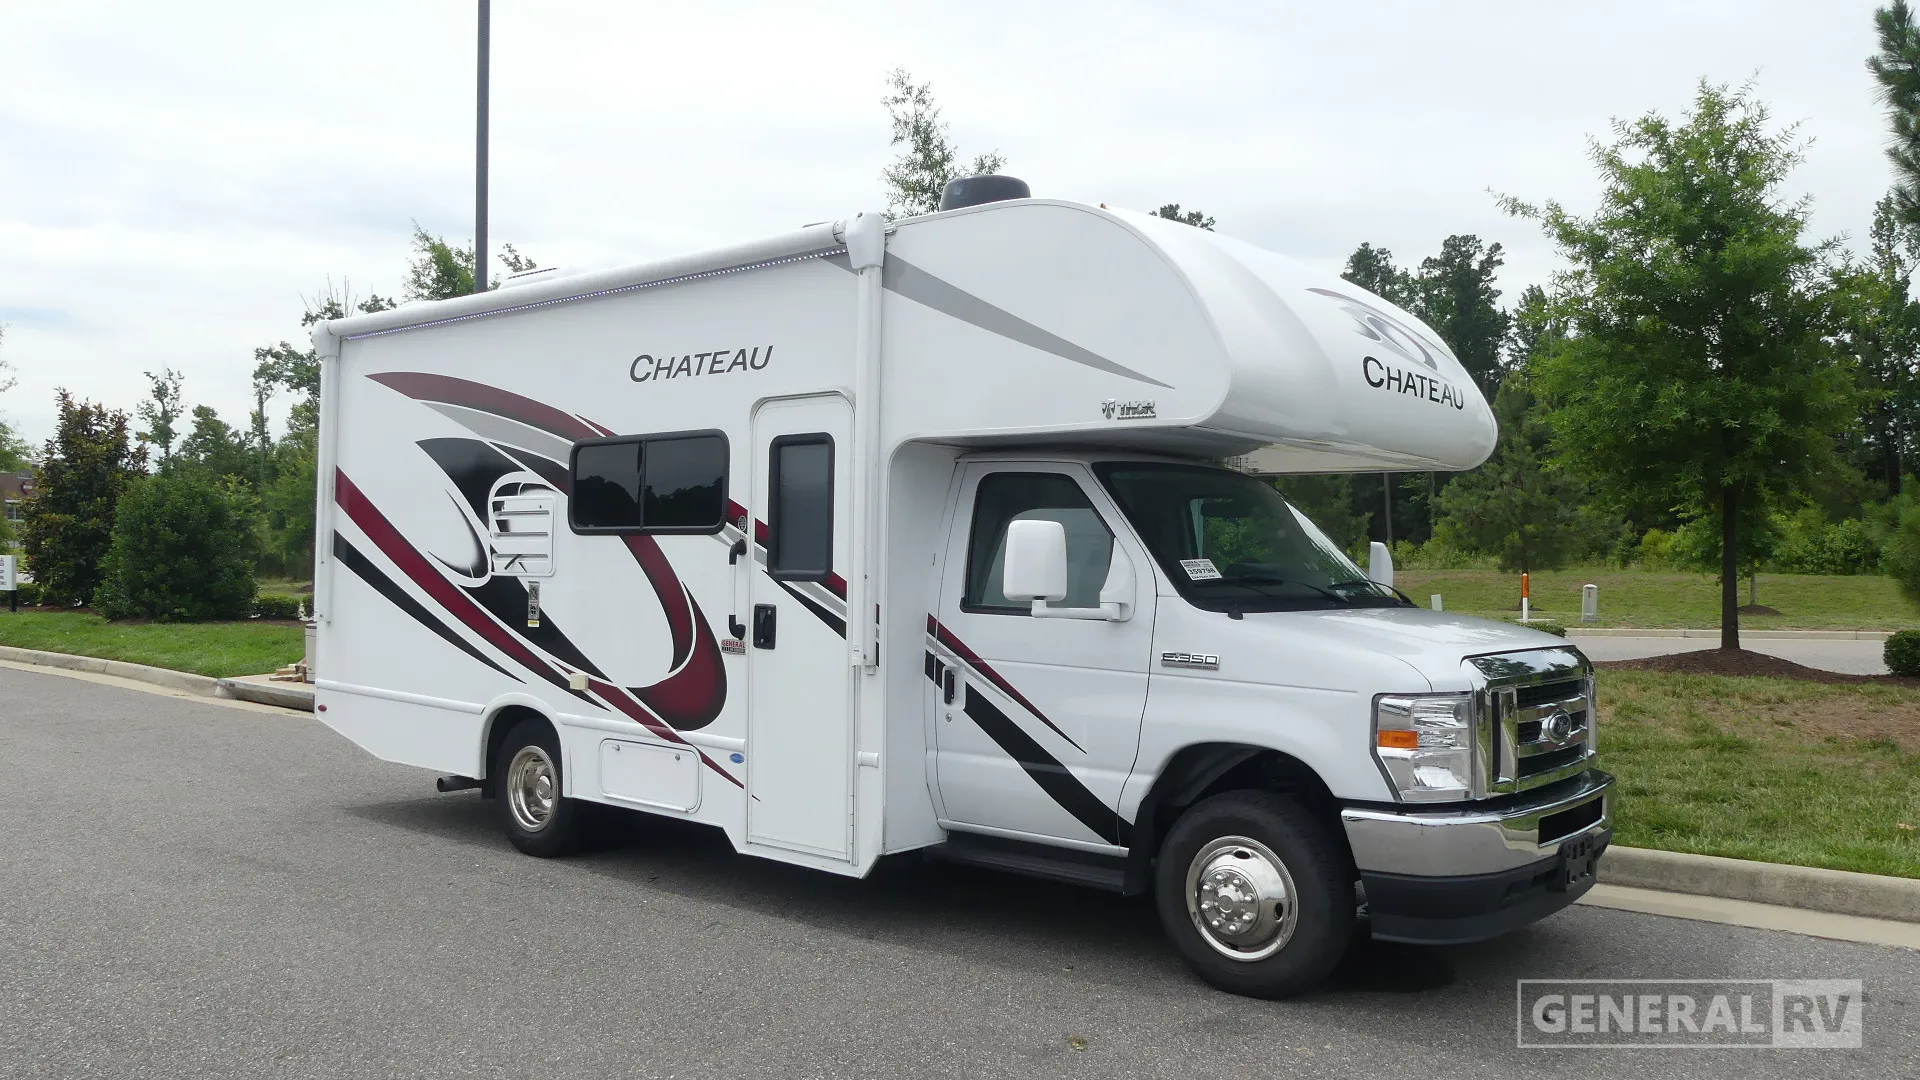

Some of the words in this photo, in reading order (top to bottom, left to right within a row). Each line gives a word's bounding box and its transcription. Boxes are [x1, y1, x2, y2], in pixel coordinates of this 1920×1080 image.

[629, 345, 774, 383] CHATEAU
[1362, 355, 1464, 411] CHATEAU
[1116, 399, 1157, 416] THOR
[721, 639, 746, 649] GENERAL
